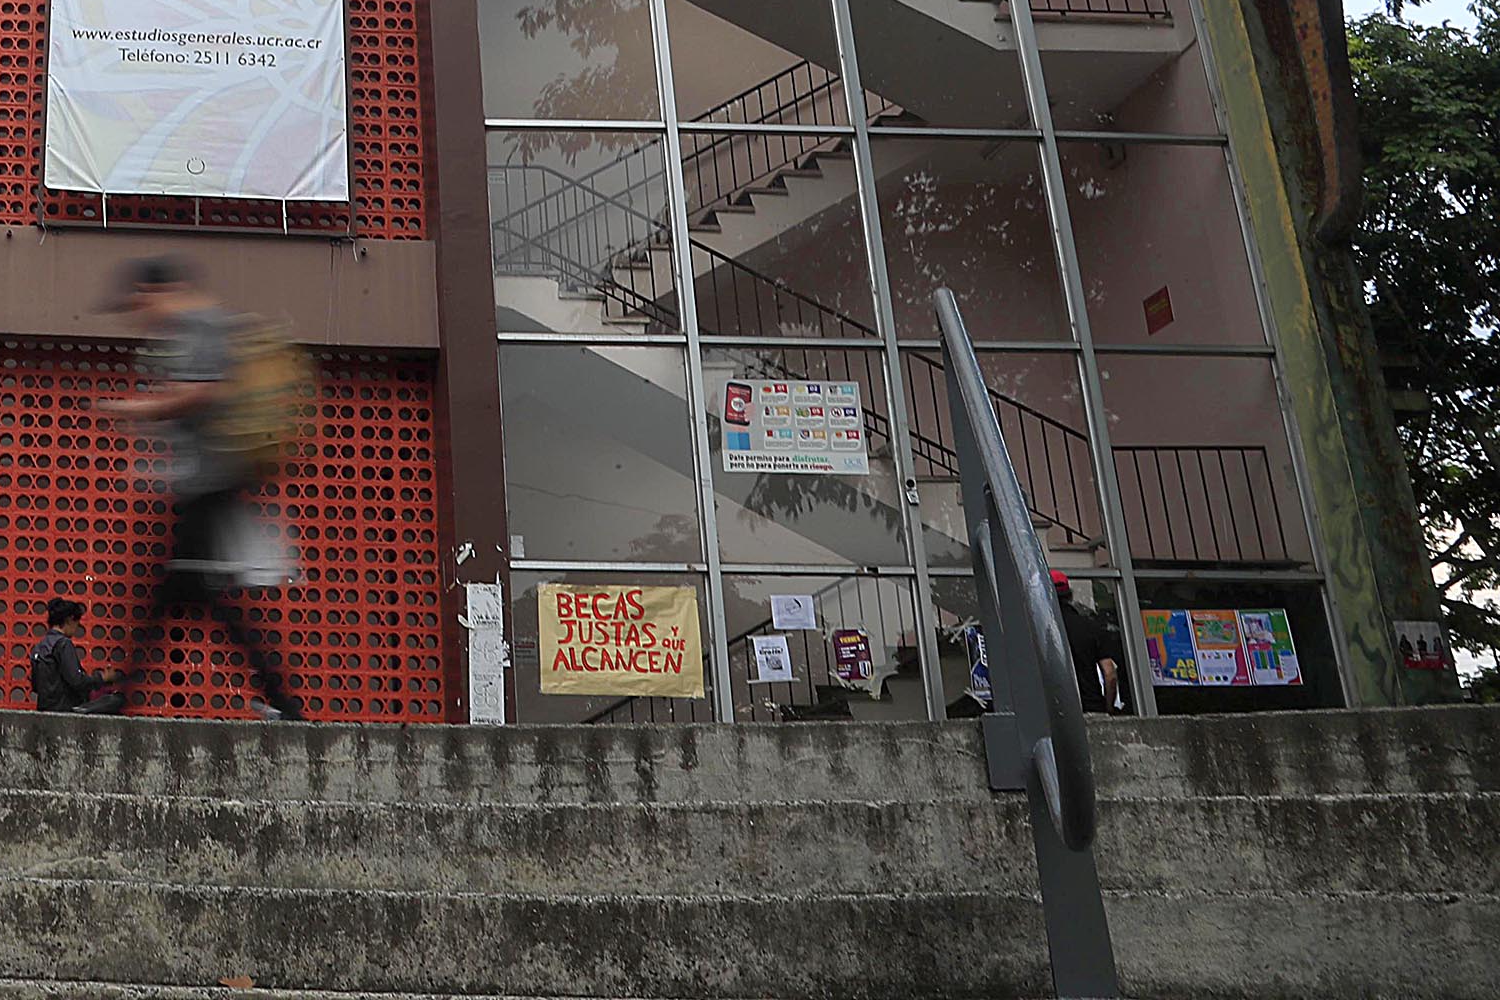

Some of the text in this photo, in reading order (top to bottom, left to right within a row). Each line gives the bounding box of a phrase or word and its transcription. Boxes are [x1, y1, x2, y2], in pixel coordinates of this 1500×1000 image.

[72, 28, 323, 50] www.estudiosgenerales.ucr.ac.cr
[118, 47, 277, 68] Teléfono: 2511 6342
[729, 454, 744, 462] Date
[745, 454, 773, 463] permiso
[774, 455, 790, 463] para
[730, 461, 745, 469] pero
[746, 461, 756, 469] no
[756, 462, 773, 470] para
[773, 462, 799, 470] ponerte
[556, 589, 645, 620] BECAS
[557, 619, 657, 649] JUSTAS
[671, 625, 679, 637] Y
[662, 638, 686, 651] QUE
[552, 646, 683, 674] ALCANCEN
